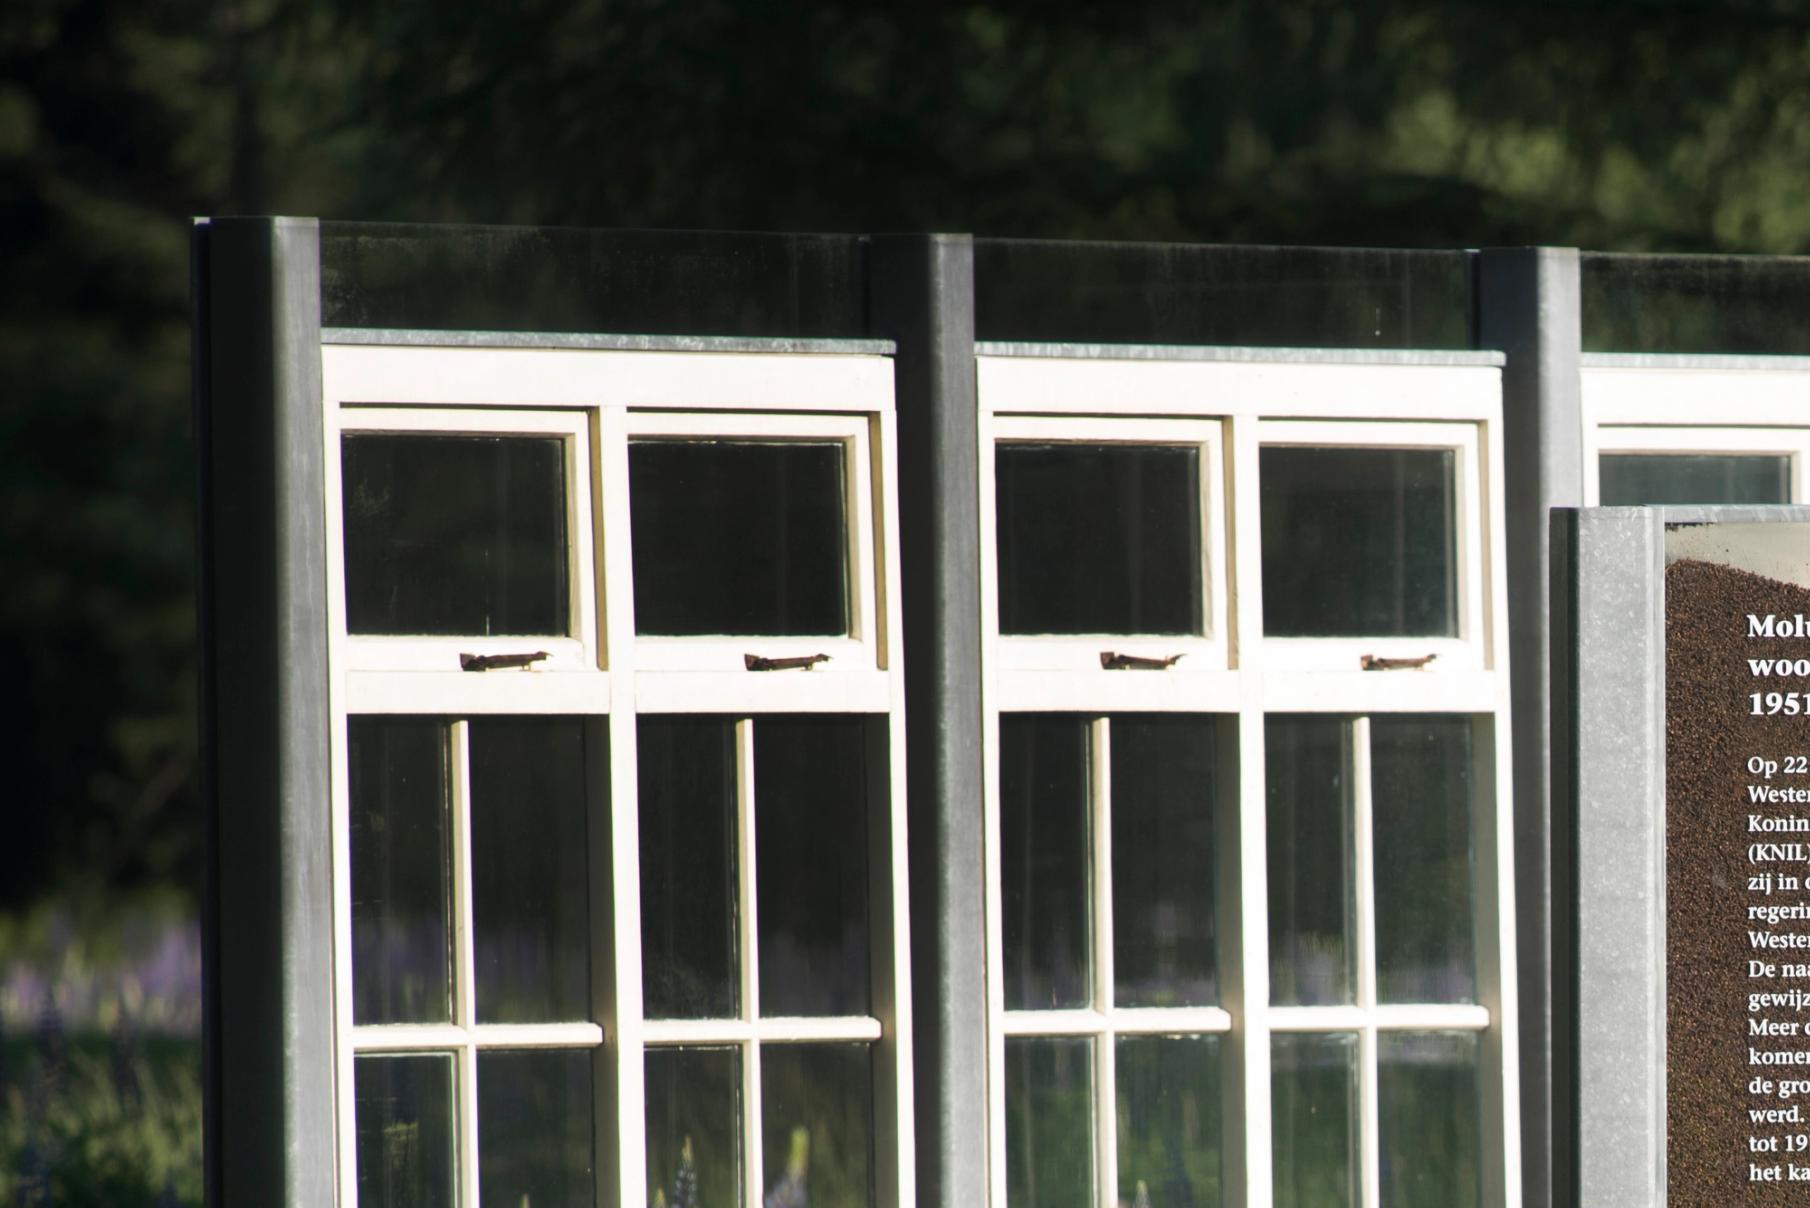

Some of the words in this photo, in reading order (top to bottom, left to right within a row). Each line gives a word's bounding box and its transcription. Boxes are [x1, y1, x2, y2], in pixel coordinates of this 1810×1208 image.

[1747, 756, 1778, 779] Op
[1783, 756, 1808, 774] 22
[1747, 872, 1772, 896] zij
[1777, 872, 1799, 891] in
[1748, 960, 1776, 978] De
[1748, 1018, 1800, 1036] Meer
[1748, 1076, 1773, 1095] de
[1748, 1104, 1805, 1124] werd.
[1748, 1135, 1778, 1153] tot
[1749, 1163, 1783, 1182] het
